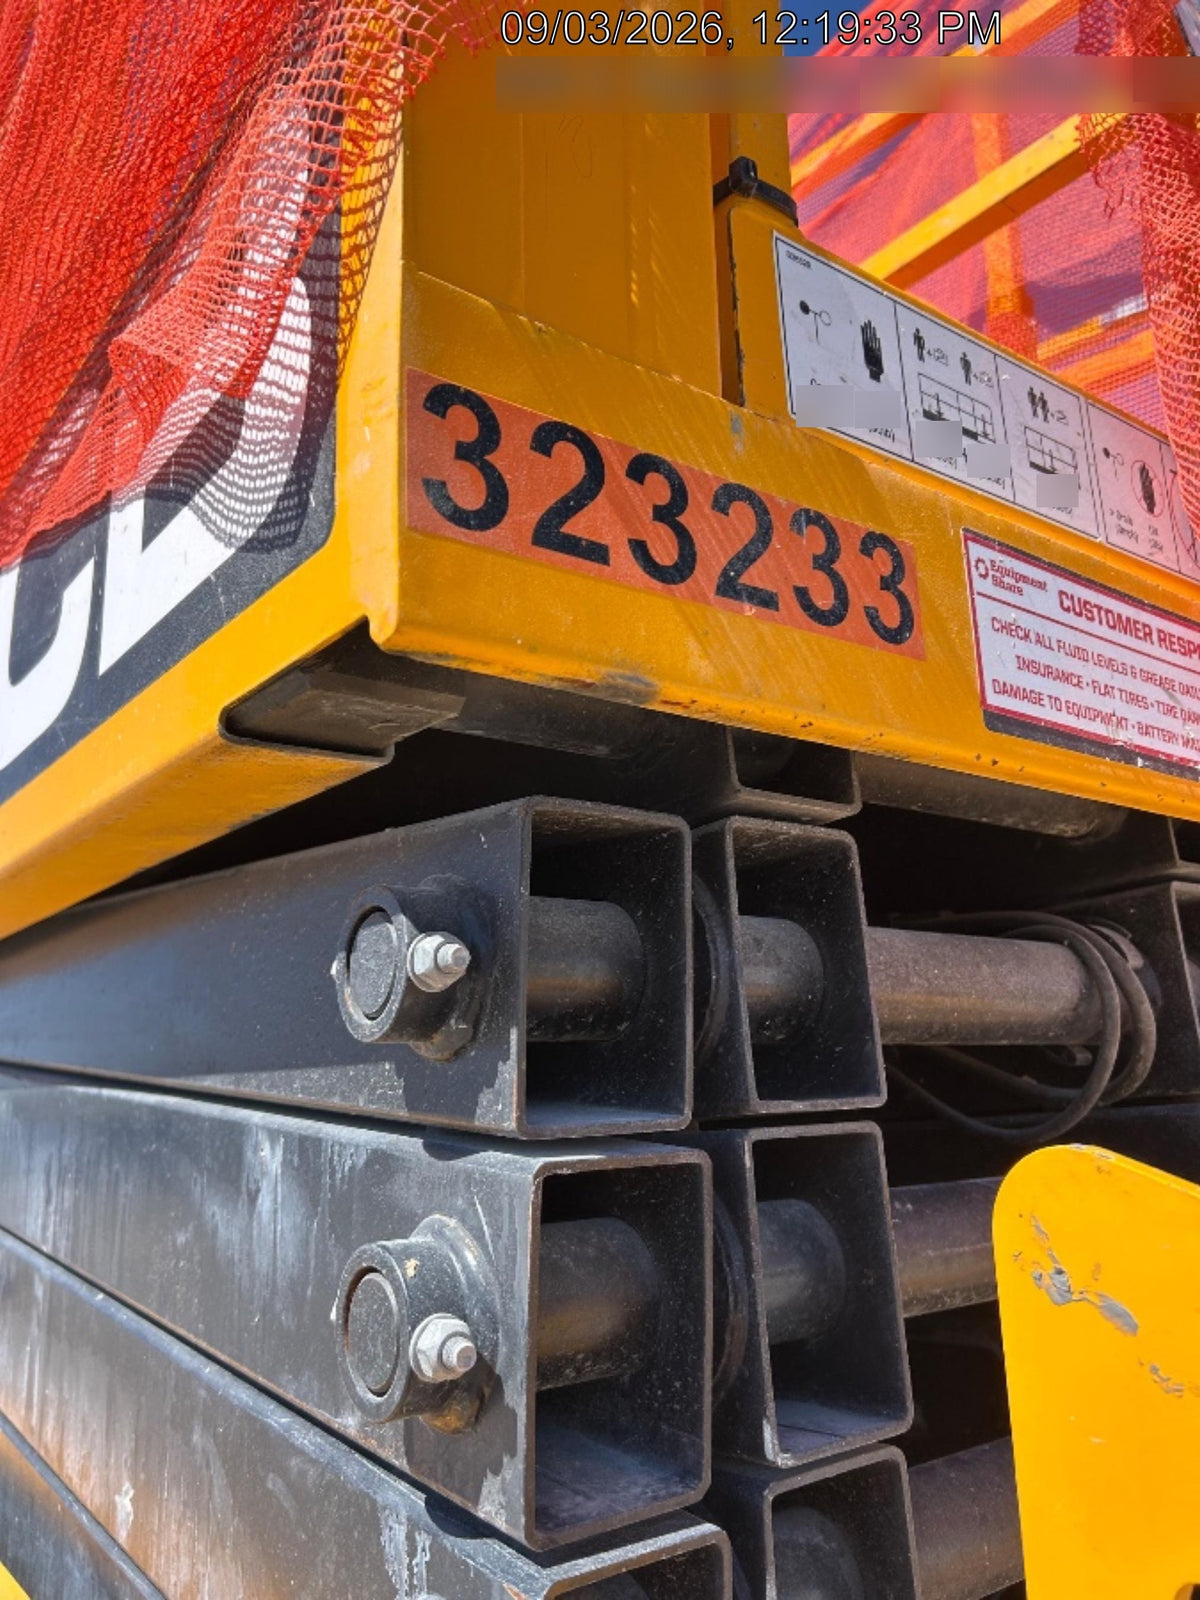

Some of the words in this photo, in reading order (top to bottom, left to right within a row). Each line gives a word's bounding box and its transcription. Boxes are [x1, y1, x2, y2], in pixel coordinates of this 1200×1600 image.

[421, 383, 916, 646] 323233
[990, 559, 1048, 592] Equipment
[991, 574, 1024, 596] Share
[1058, 589, 1154, 646] CUSTOMER
[990, 615, 1032, 643] CHECK
[1035, 631, 1054, 652] ALL
[1057, 640, 1089, 664] FLUID
[1092, 652, 1129, 677] LEVELS
[1139, 667, 1178, 692] GREASE
[991, 679, 1046, 707] DAMAGE
[1048, 693, 1062, 712] TO
[1065, 700, 1128, 731] EQUIPMENT
[1137, 720, 1180, 746] BATTERY
[1015, 654, 1083, 690] INSURANCE
[1092, 680, 1116, 700] FLAT
[1117, 687, 1150, 711] TIRES
[1155, 699, 1179, 719] TIRE
